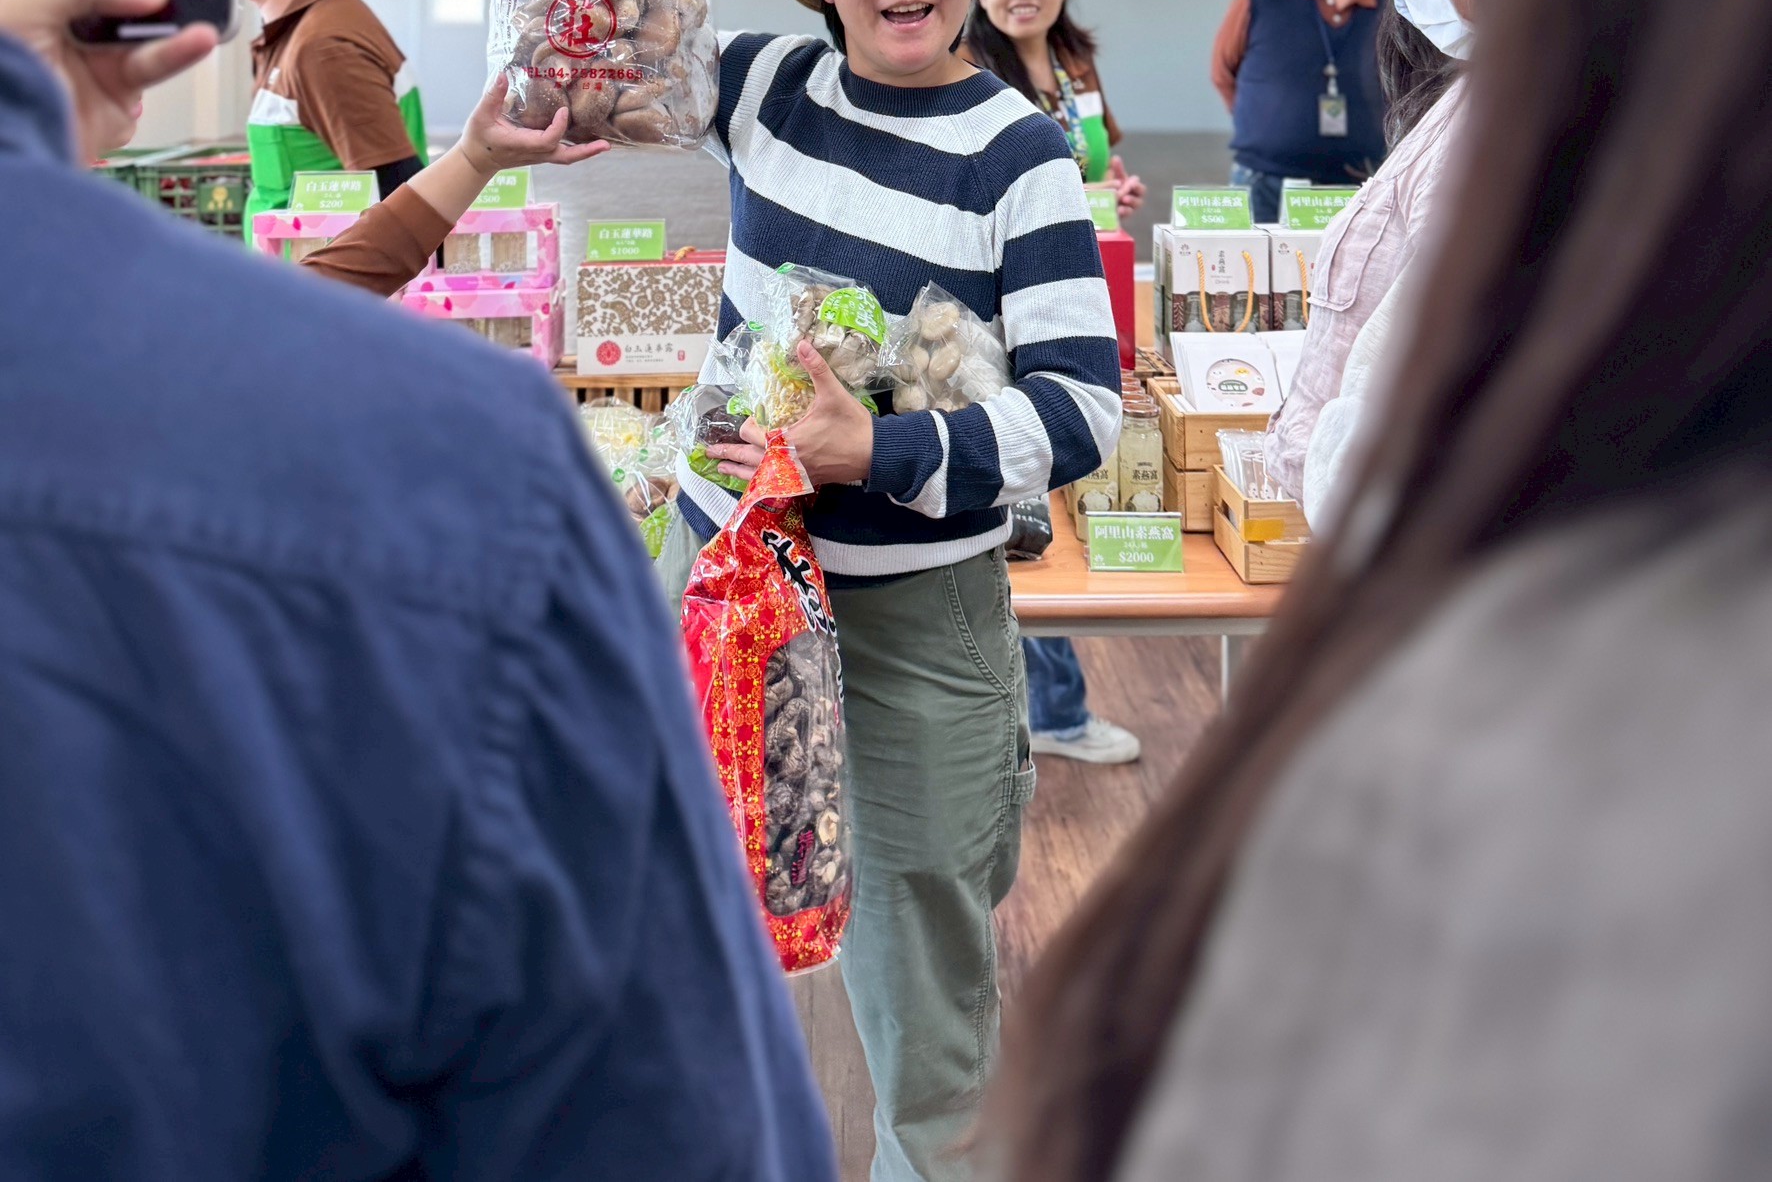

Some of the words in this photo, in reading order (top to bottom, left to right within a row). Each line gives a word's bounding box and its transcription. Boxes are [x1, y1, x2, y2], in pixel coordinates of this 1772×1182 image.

[319, 199, 343, 209] $200
[1178, 196, 1243, 208] 阿里山素燕窩
[1201, 214, 1225, 224] $500
[1094, 525, 1175, 541] 阿里山素燕窩
[1118, 551, 1155, 564] $2000
